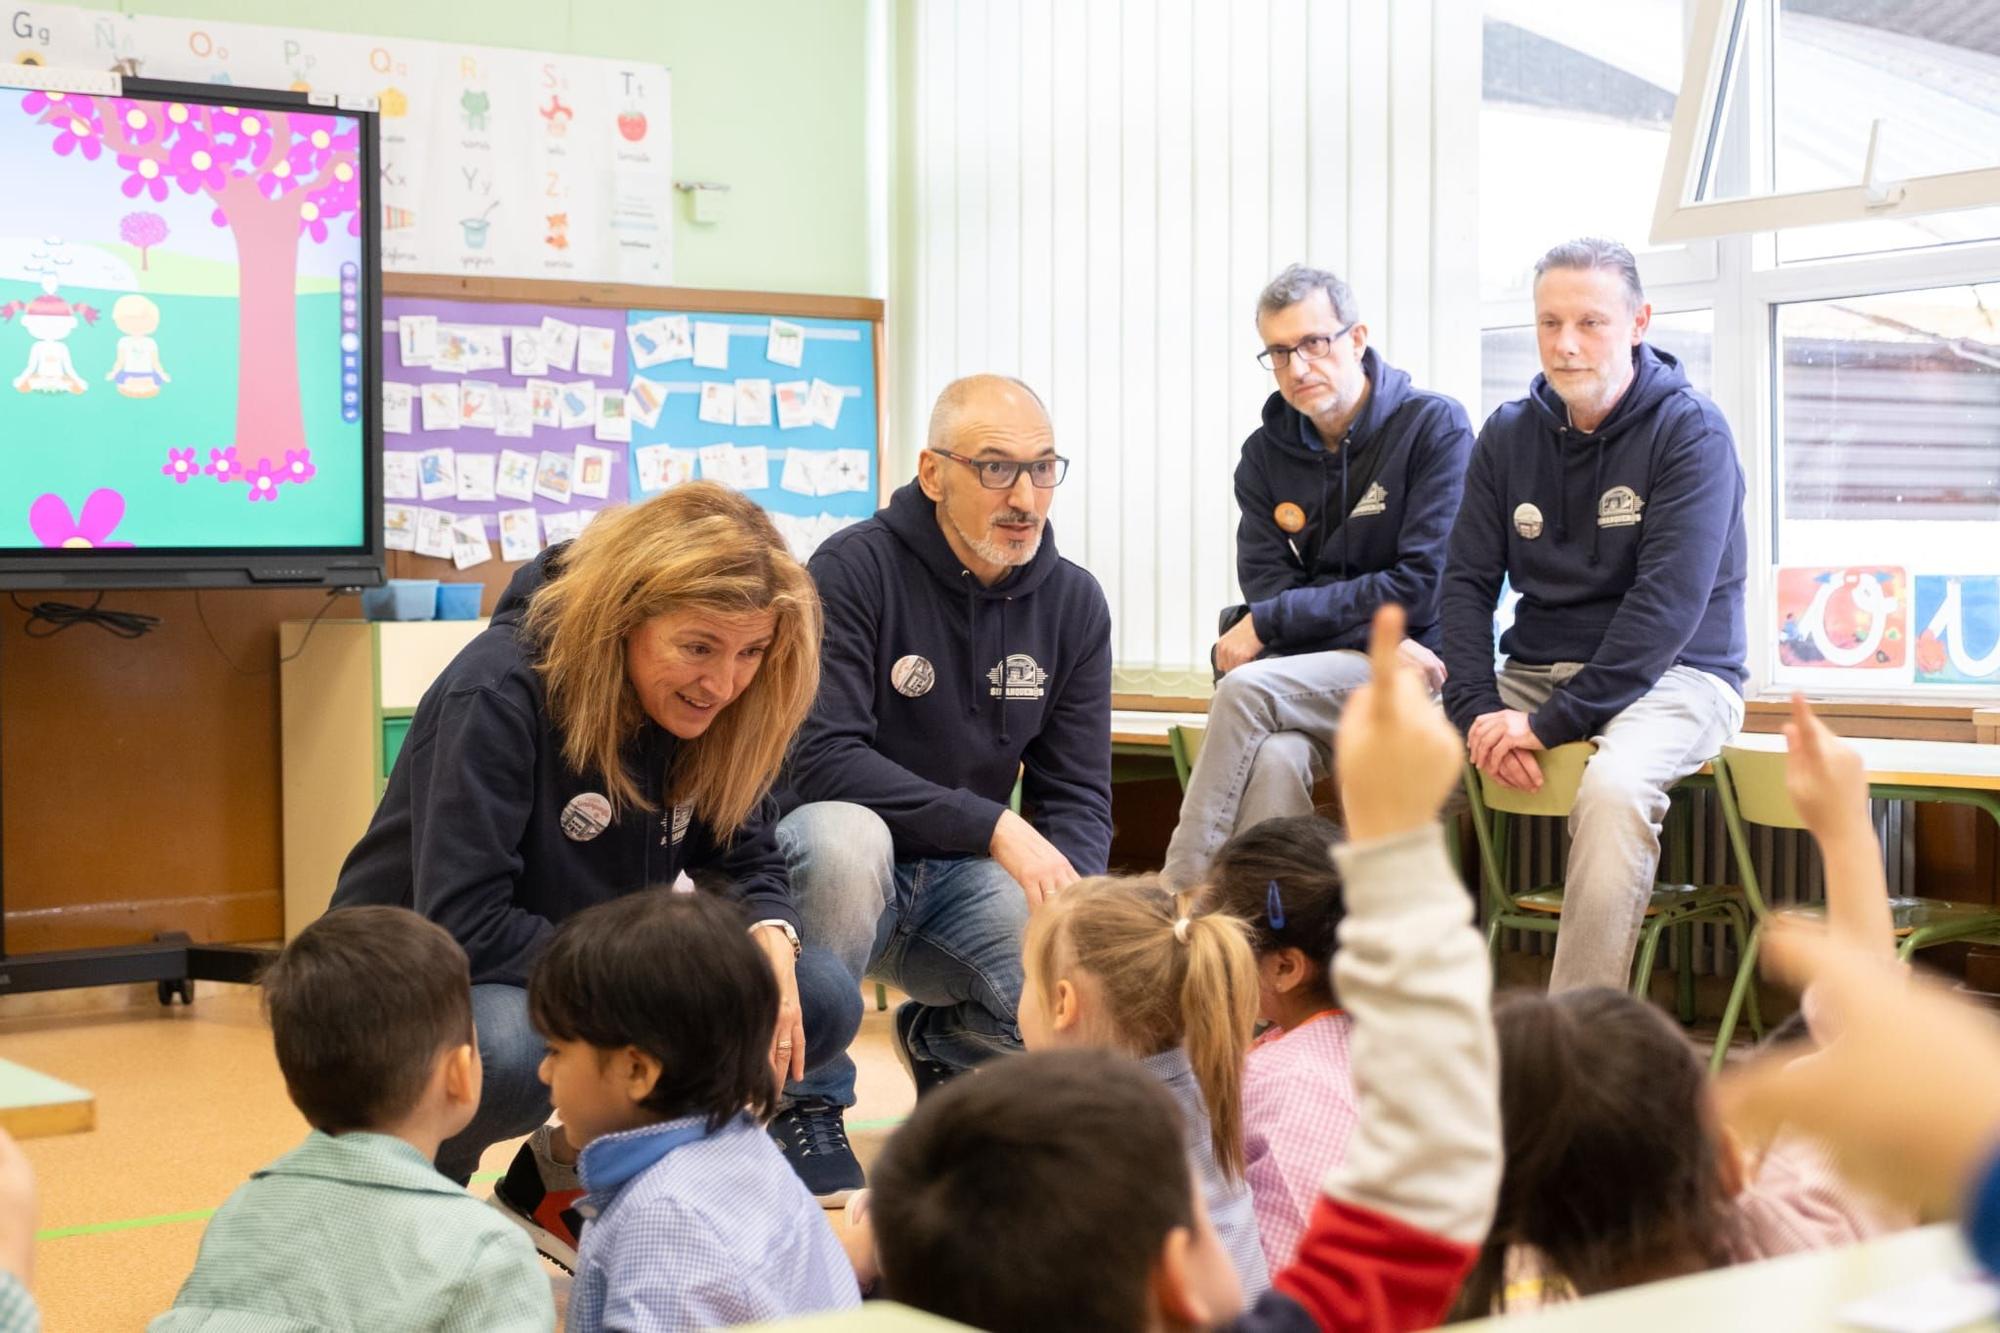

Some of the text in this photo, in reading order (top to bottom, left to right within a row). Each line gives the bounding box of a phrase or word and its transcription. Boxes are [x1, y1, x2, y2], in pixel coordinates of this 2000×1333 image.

[12, 11, 50, 46] Gg
[283, 39, 317, 69] Pp
[619, 71, 645, 98] Tt
